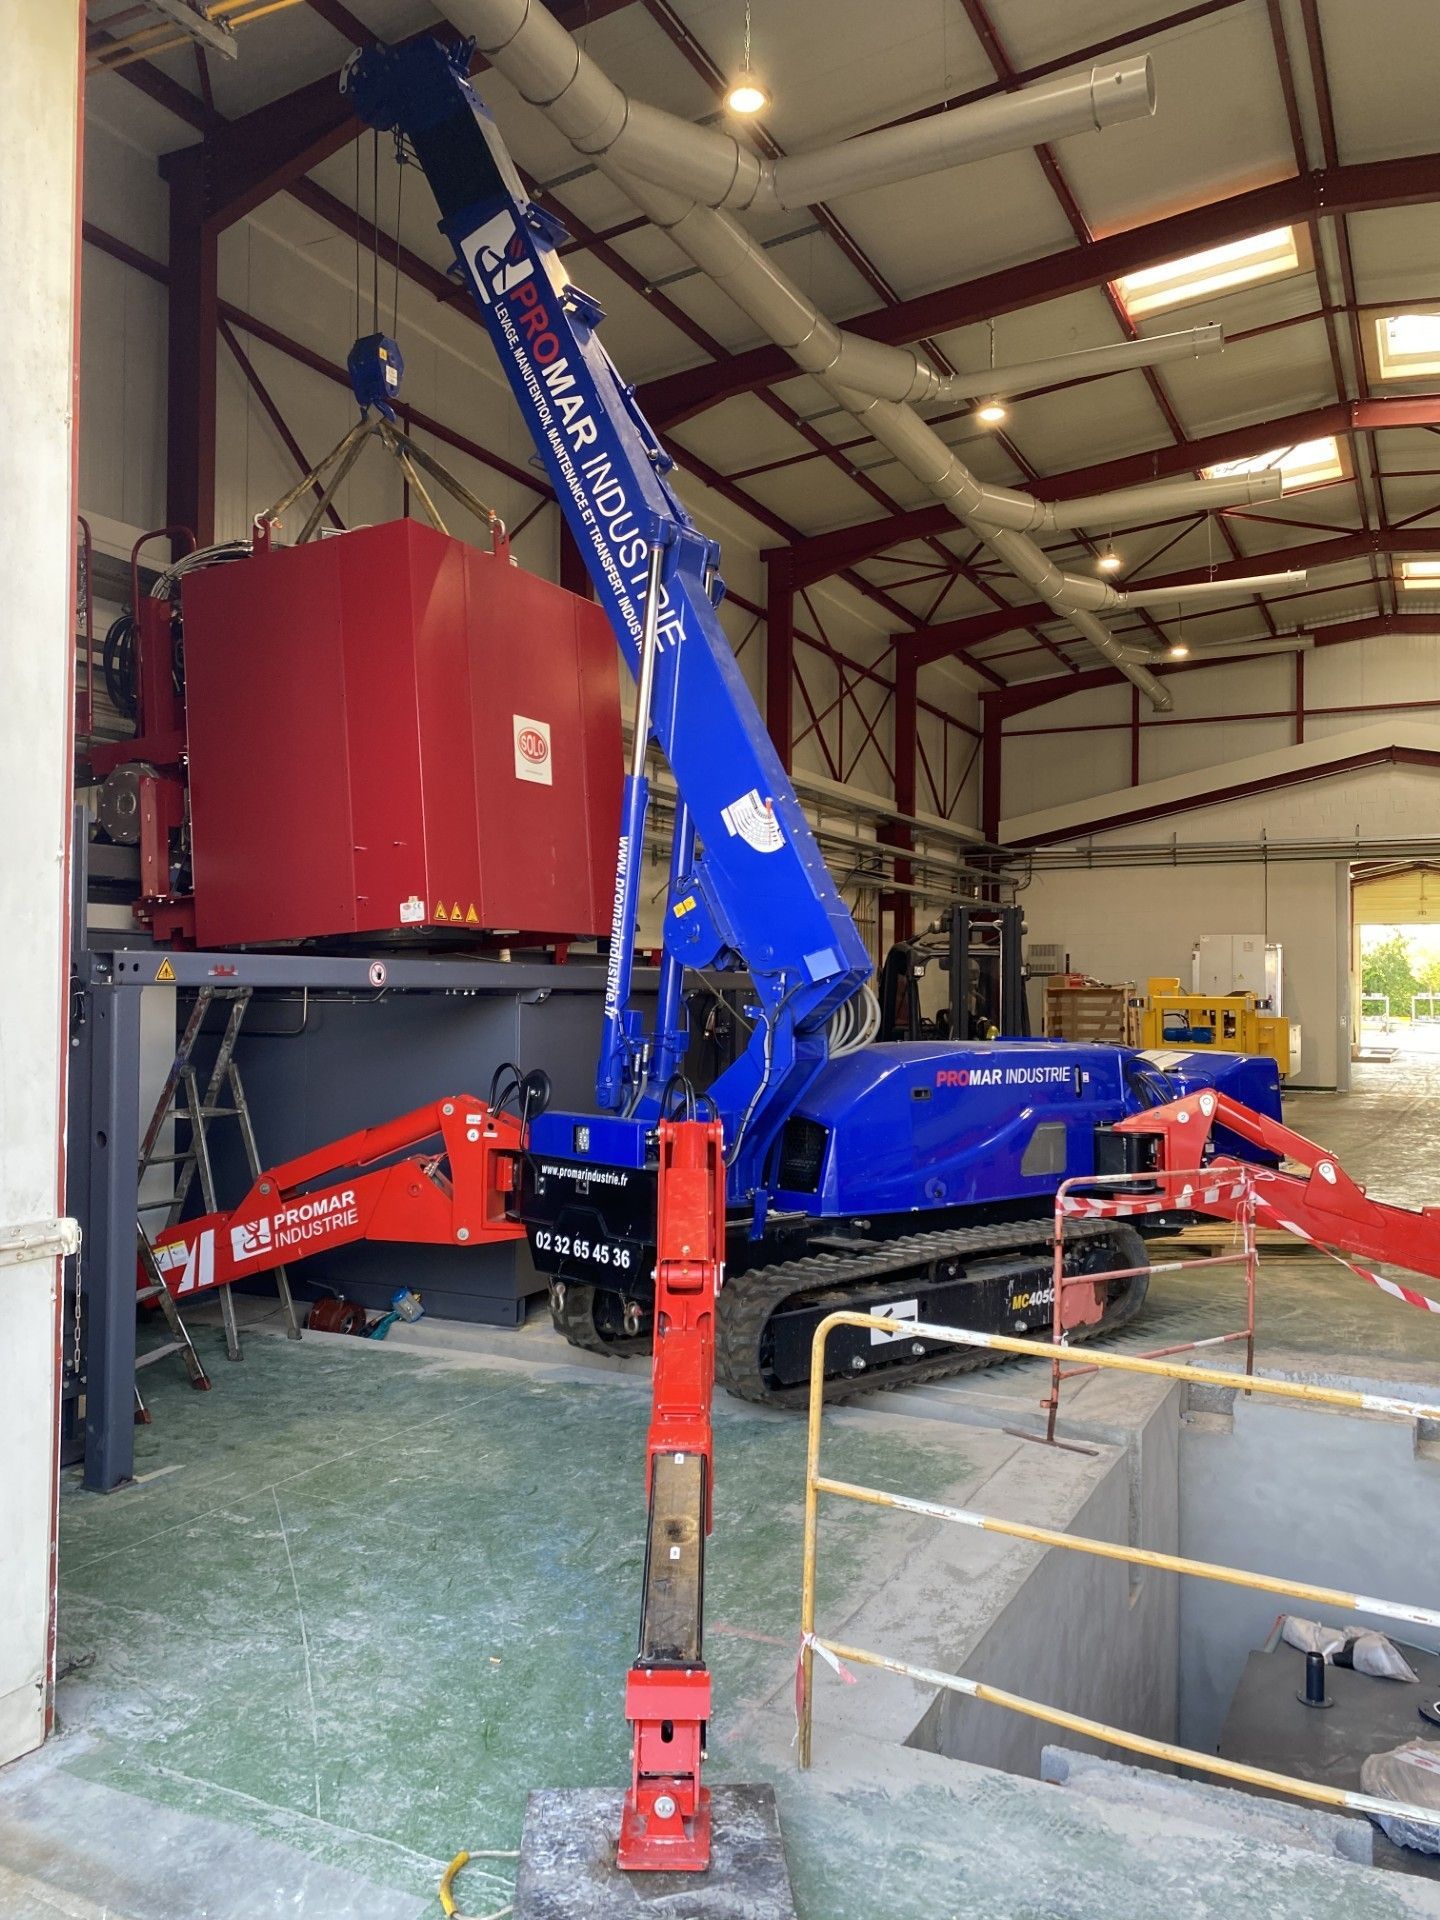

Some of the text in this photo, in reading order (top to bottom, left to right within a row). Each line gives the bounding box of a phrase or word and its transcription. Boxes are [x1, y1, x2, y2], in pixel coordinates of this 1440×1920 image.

[494, 302, 519, 350] LEVAGE,
[510, 281, 597, 452] PROMAR
[513, 347, 554, 430] MANUTENTION,
[547, 427, 589, 510] MAINTENANCE
[582, 508, 597, 526] ET
[589, 524, 627, 596] TRANSFERT
[521, 734, 545, 756] SOLO
[605, 836, 629, 1020] www.promarindustrie.fr
[936, 1066, 1071, 1088] PROMAR INDUSTRIE
[541, 1165, 628, 1187] www.promarindustrie.fr
[274, 1190, 356, 1230] PROMAR
[274, 1208, 359, 1249] INDUSTRIE
[535, 1230, 631, 1269] 02 32 65 45 36
